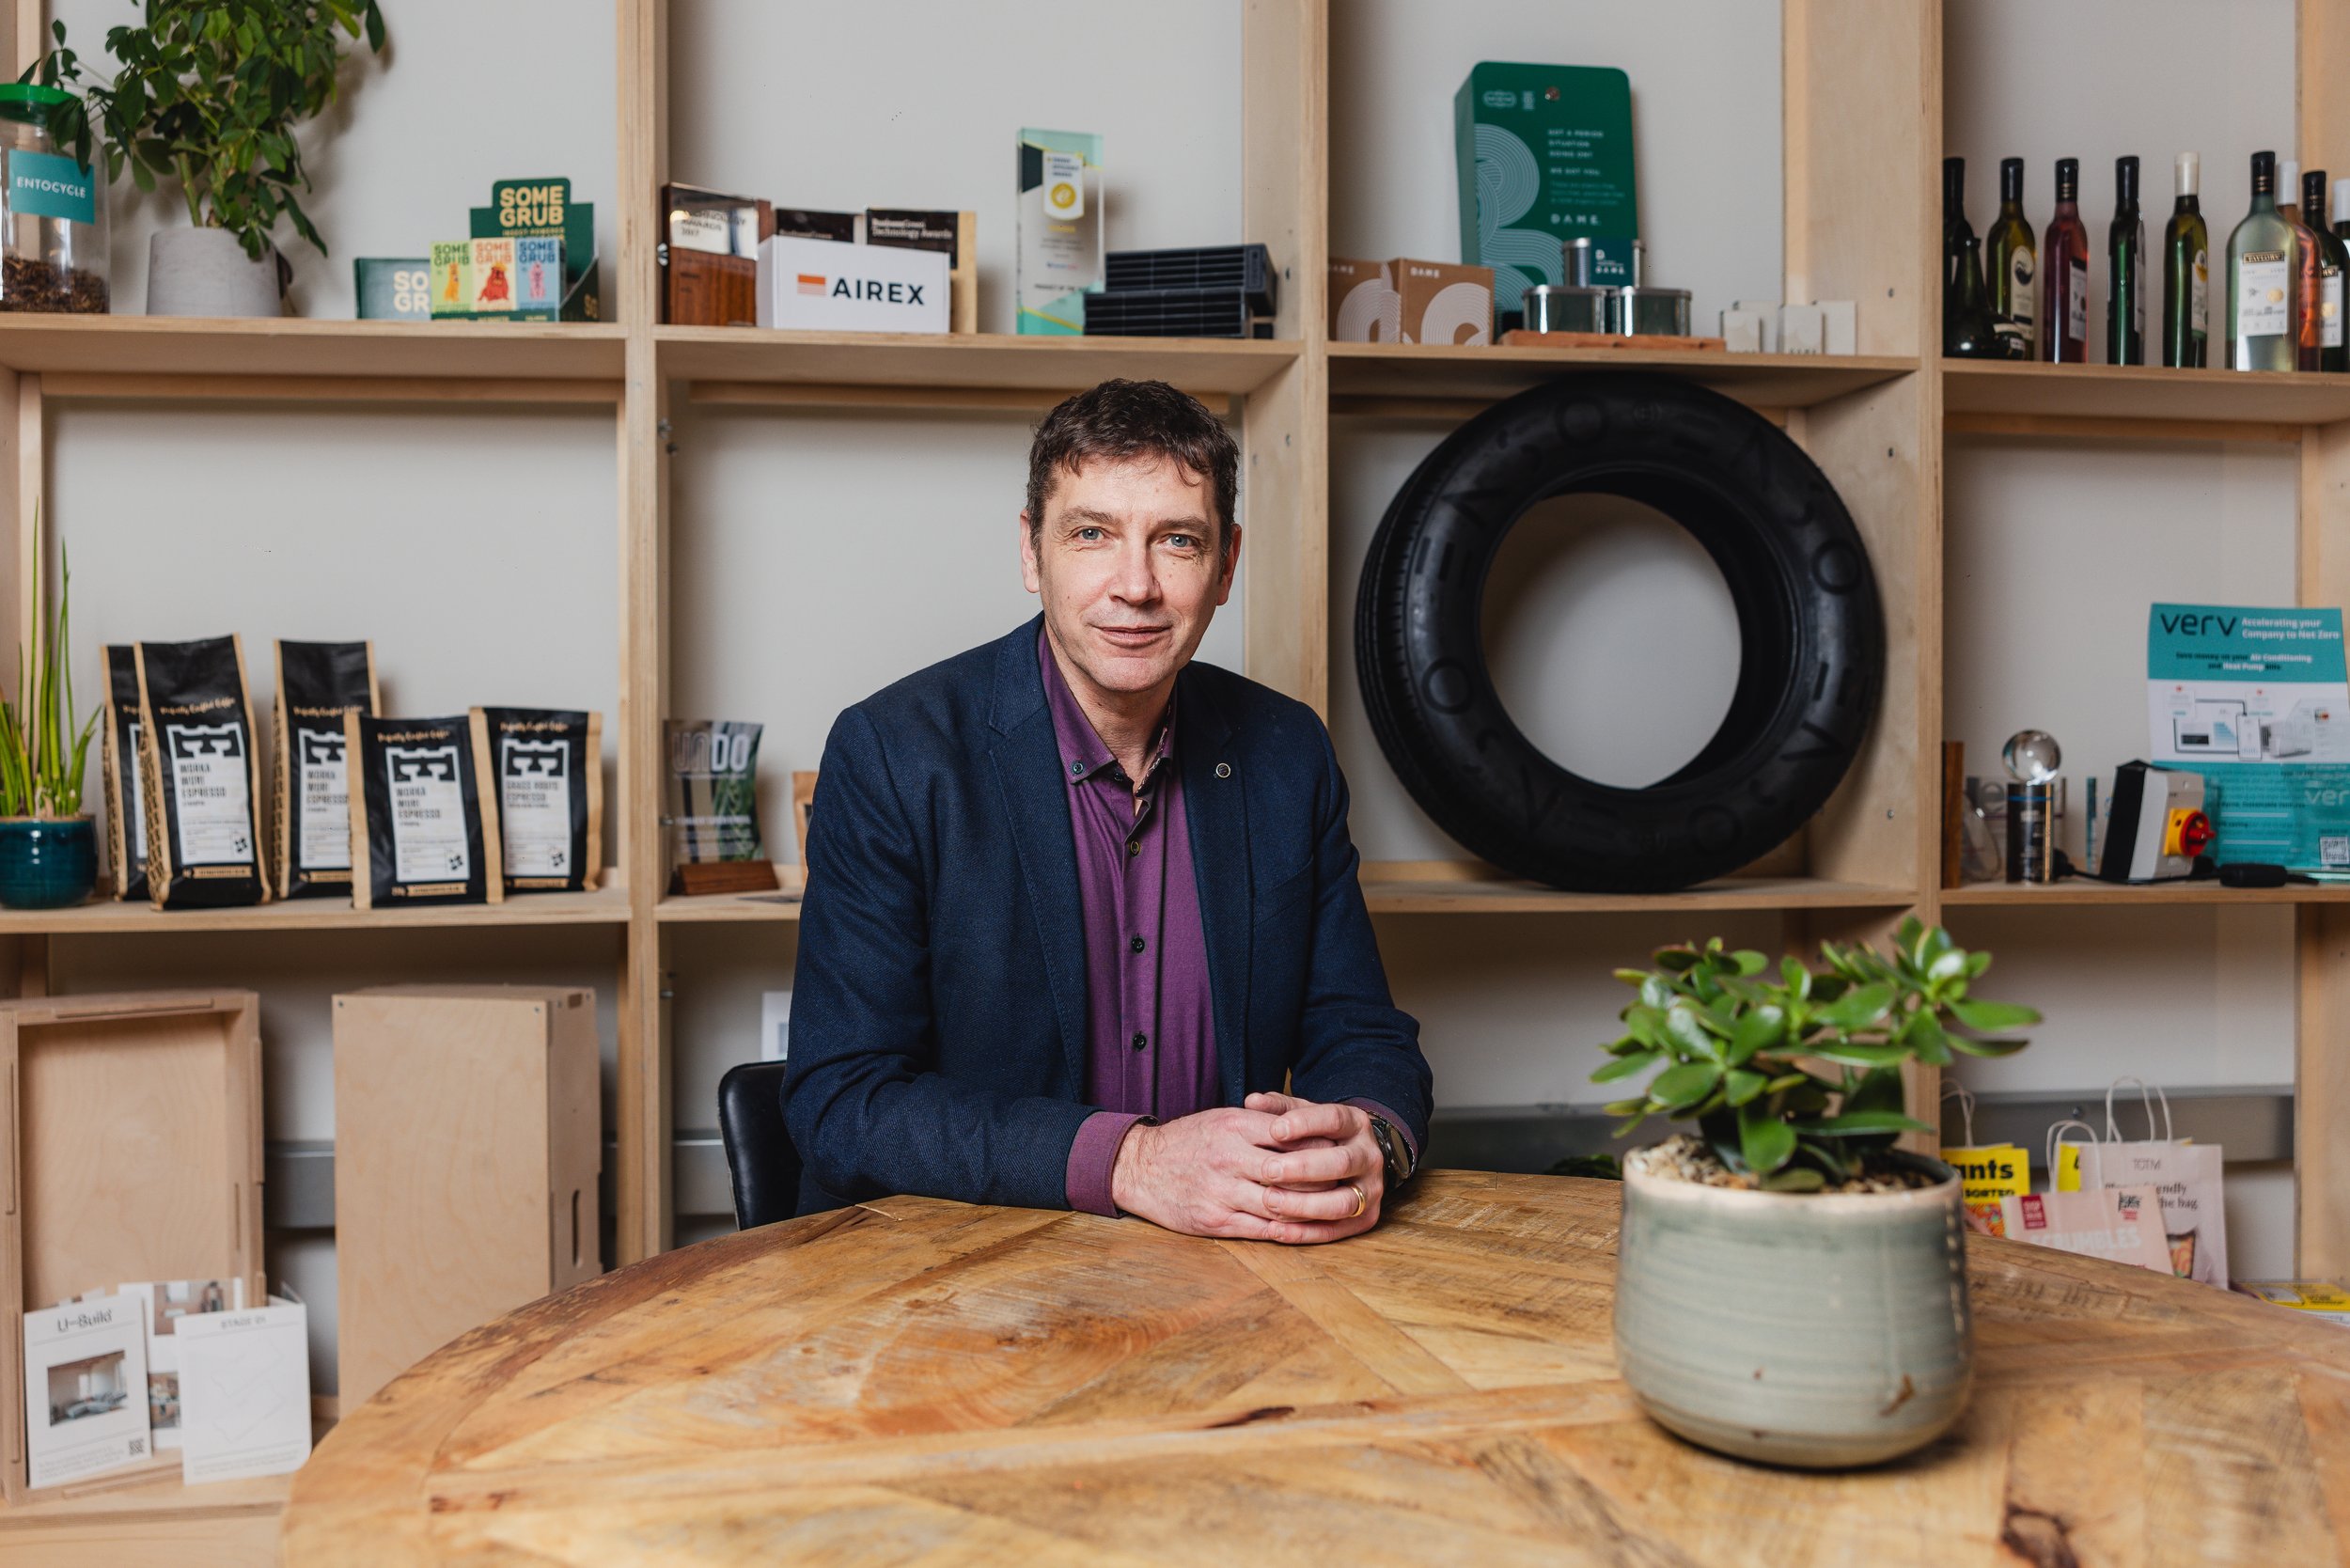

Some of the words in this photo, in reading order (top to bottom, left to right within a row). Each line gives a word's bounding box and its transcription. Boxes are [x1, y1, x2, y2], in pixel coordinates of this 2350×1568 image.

[16, 176, 86, 199] ENTOCYCLE
[499, 185, 564, 208] SOME
[499, 206, 564, 227] GRUB
[433, 243, 469, 256] SOME
[476, 241, 512, 253] SOME
[519, 241, 556, 252] SOME
[519, 252, 556, 264] GRUB
[393, 271, 430, 292] SO
[833, 277, 925, 306] AIREX
[393, 292, 430, 313] GR
[2160, 613, 2237, 636] verv
[2242, 617, 2297, 629] Accelerating
[2299, 619, 2322, 629] your
[2242, 628, 2285, 641] Company
[2286, 630, 2296, 639] to
[2298, 630, 2316, 639] Net
[2318, 631, 2341, 640] Zero
[2250, 653, 2262, 662] Air
[2263, 654, 2312, 664] Conditioning
[2242, 663, 2264, 672] Pump
[181, 786, 226, 798] ESPRESSO
[399, 808, 442, 819] ESPRESSO
[1963, 1188, 2014, 1199] SORTED
